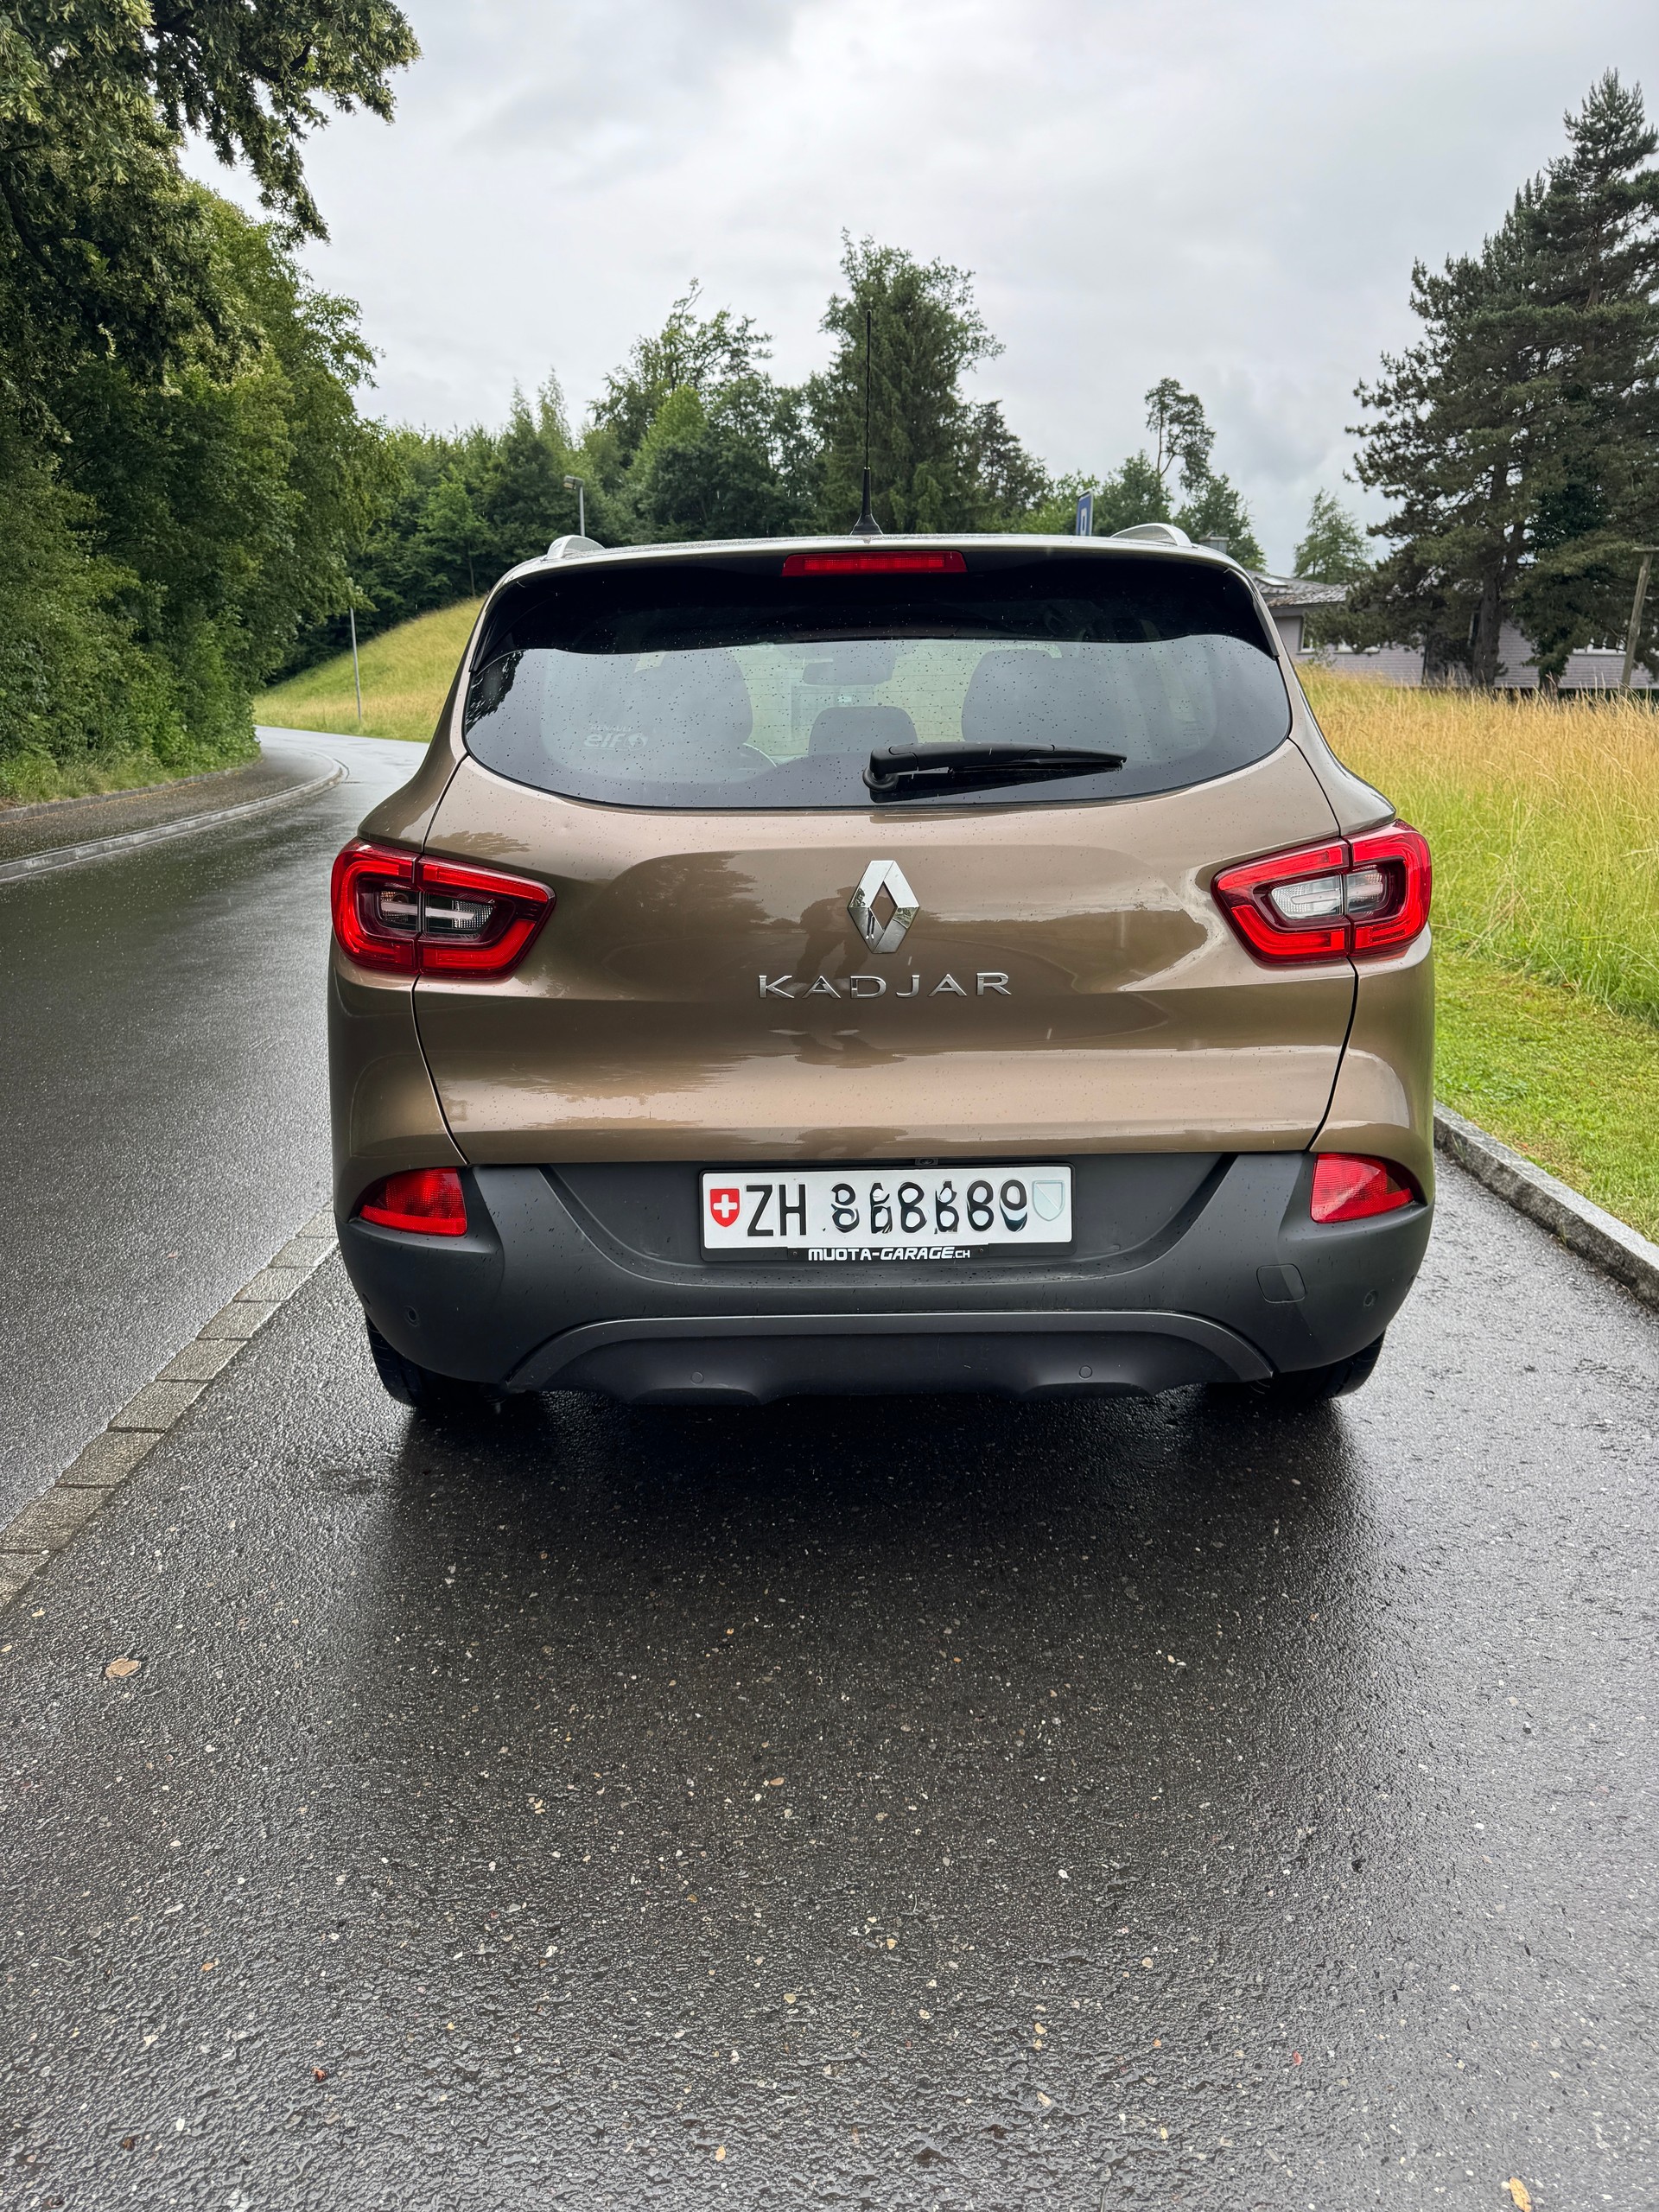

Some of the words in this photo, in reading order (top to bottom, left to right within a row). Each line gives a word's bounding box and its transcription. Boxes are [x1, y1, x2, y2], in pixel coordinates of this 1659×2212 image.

[758, 971, 1012, 1000] KADJAR
[746, 1183, 807, 1236] ZH
[808, 1246, 971, 1262] MUOTA-GARAGE.CH
